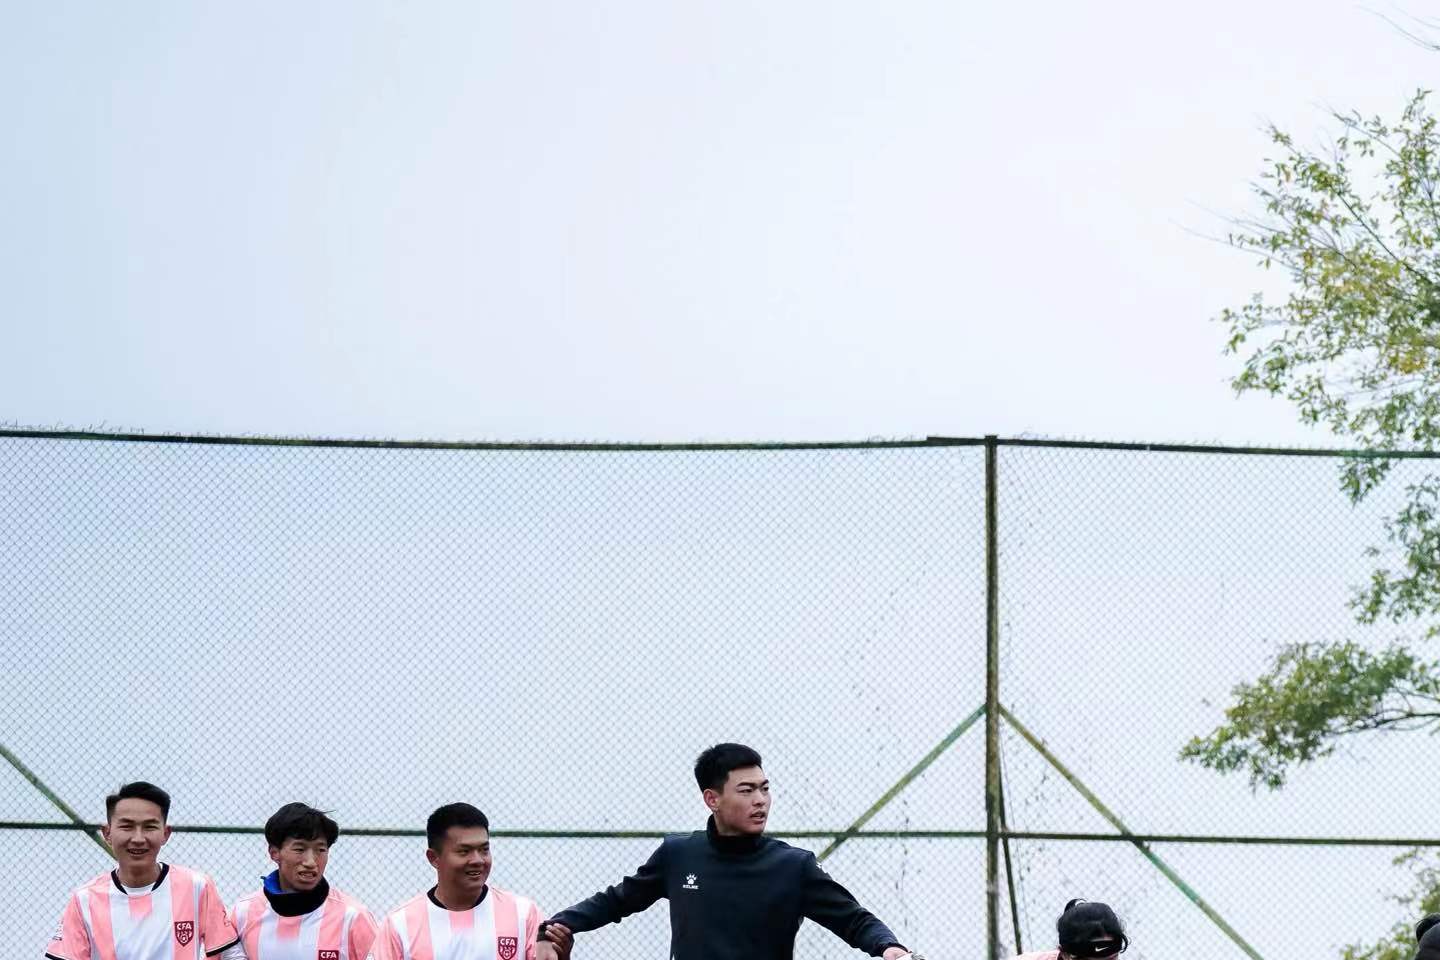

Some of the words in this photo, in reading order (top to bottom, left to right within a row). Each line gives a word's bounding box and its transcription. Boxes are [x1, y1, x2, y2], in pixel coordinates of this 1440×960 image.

[176, 922, 192, 931] CFA
[499, 938, 515, 946] CFA
[320, 951, 337, 959] CFA
